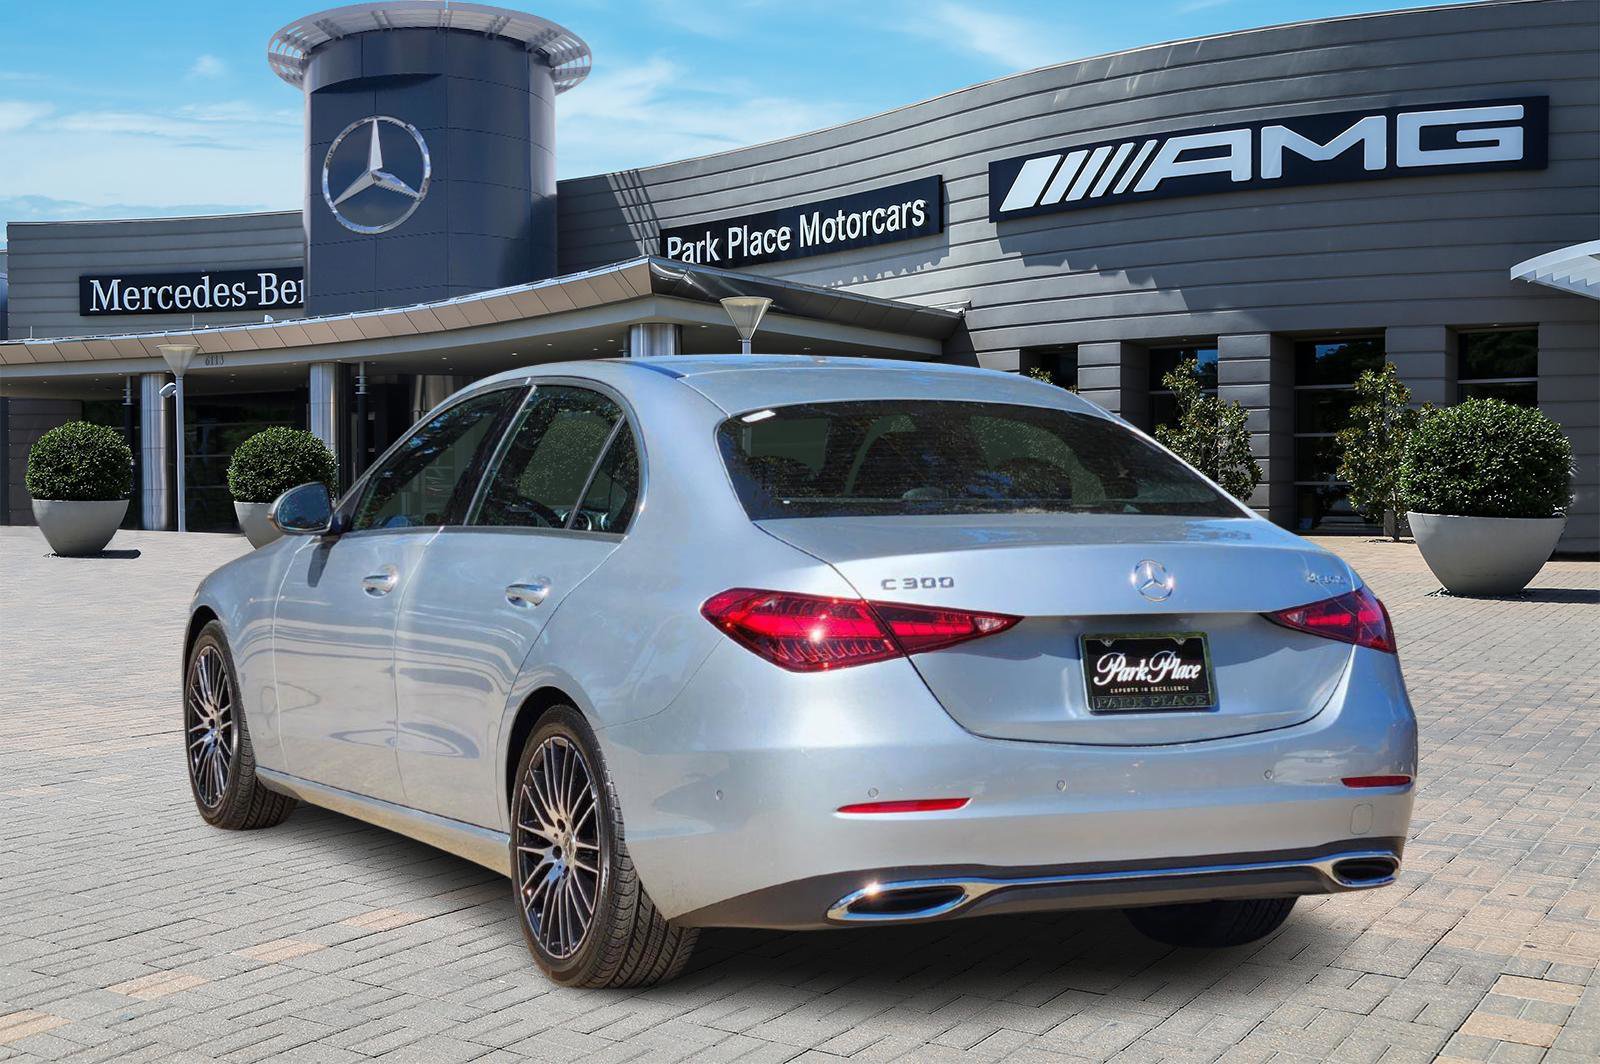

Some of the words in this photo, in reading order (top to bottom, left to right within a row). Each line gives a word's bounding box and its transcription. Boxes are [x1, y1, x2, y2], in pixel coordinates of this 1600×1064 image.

[1133, 105, 1524, 192] AMG
[667, 231, 721, 264] Park
[728, 225, 792, 259] Place
[799, 199, 927, 248] Motorcars
[881, 578, 897, 591] C
[902, 576, 955, 590] 300
[1093, 651, 1150, 686] Park
[1146, 650, 1202, 683] Place
[1151, 695, 1207, 706] PLACE
